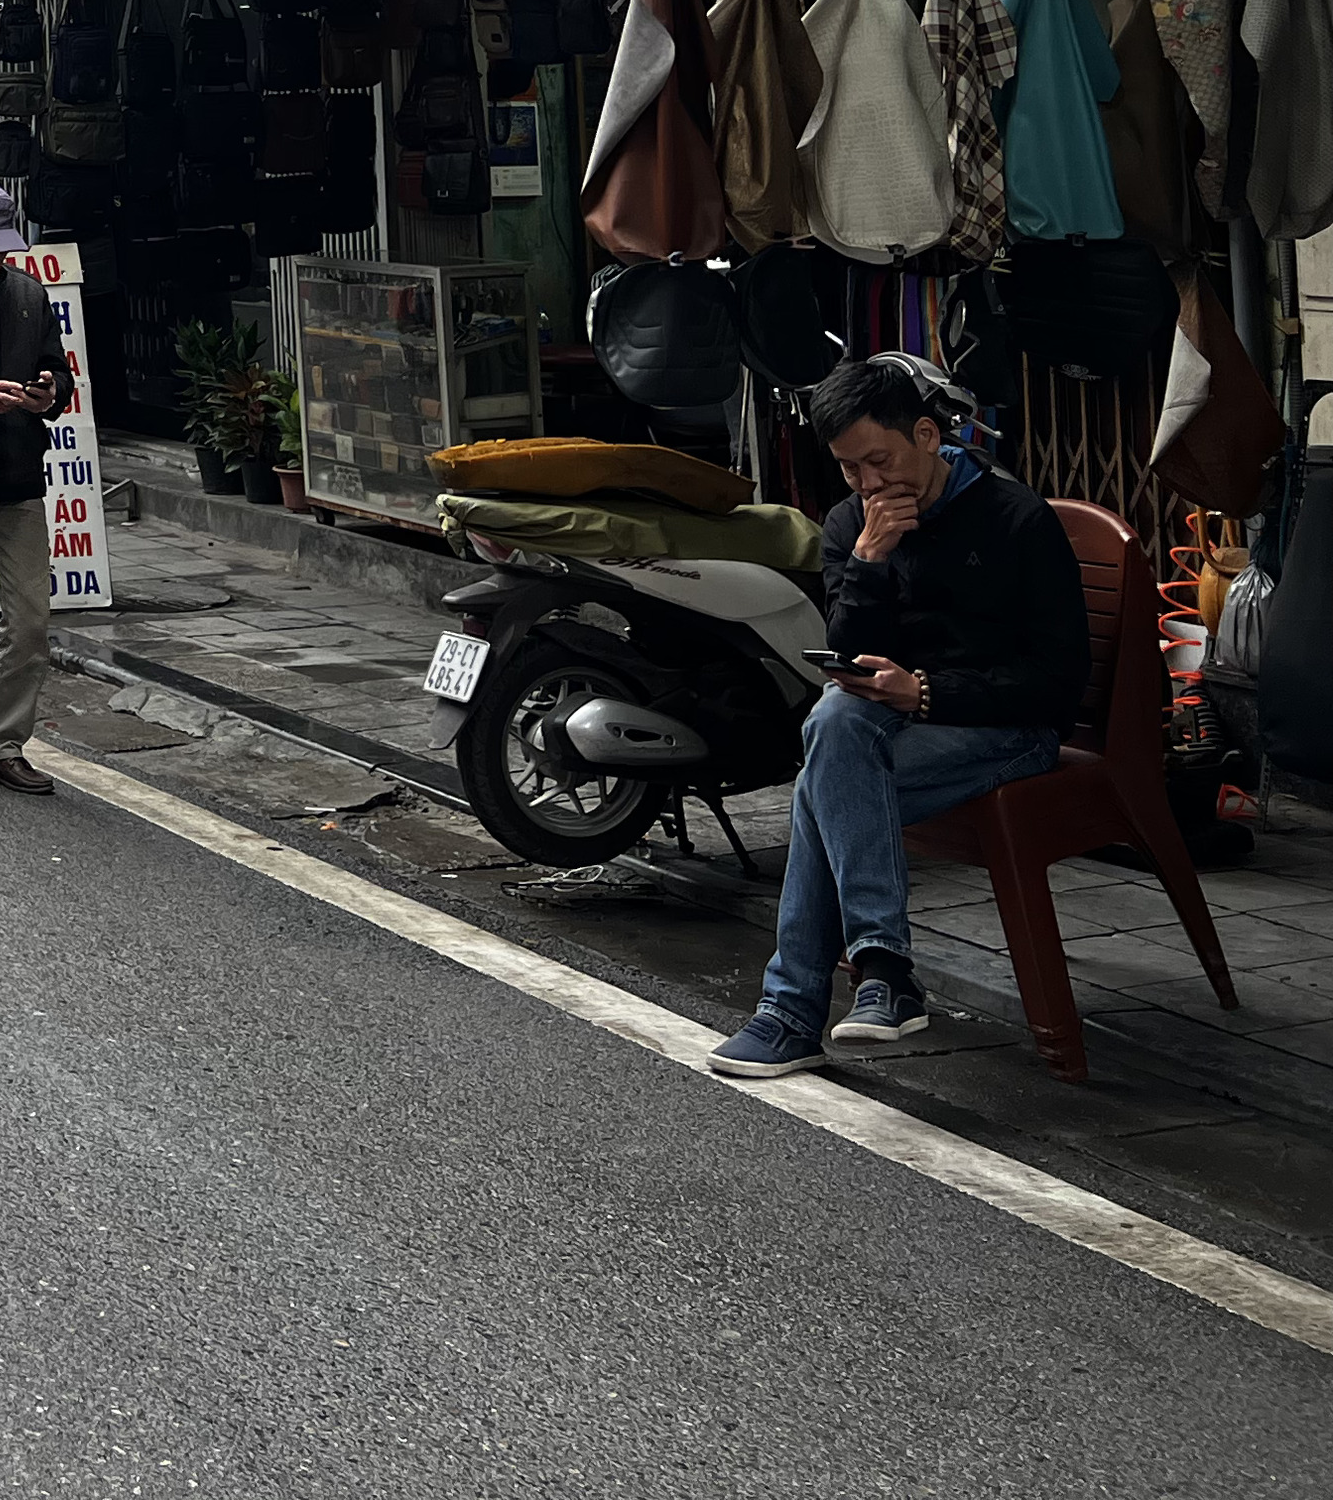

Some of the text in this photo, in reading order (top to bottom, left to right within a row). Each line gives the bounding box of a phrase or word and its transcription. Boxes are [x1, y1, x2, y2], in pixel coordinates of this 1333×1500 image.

[61, 456, 92, 486] TÚI
[54, 494, 86, 523] ÁO
[67, 570, 100, 595] DA
[439, 639, 479, 669] 29-C1
[428, 664, 473, 696] 485.41
